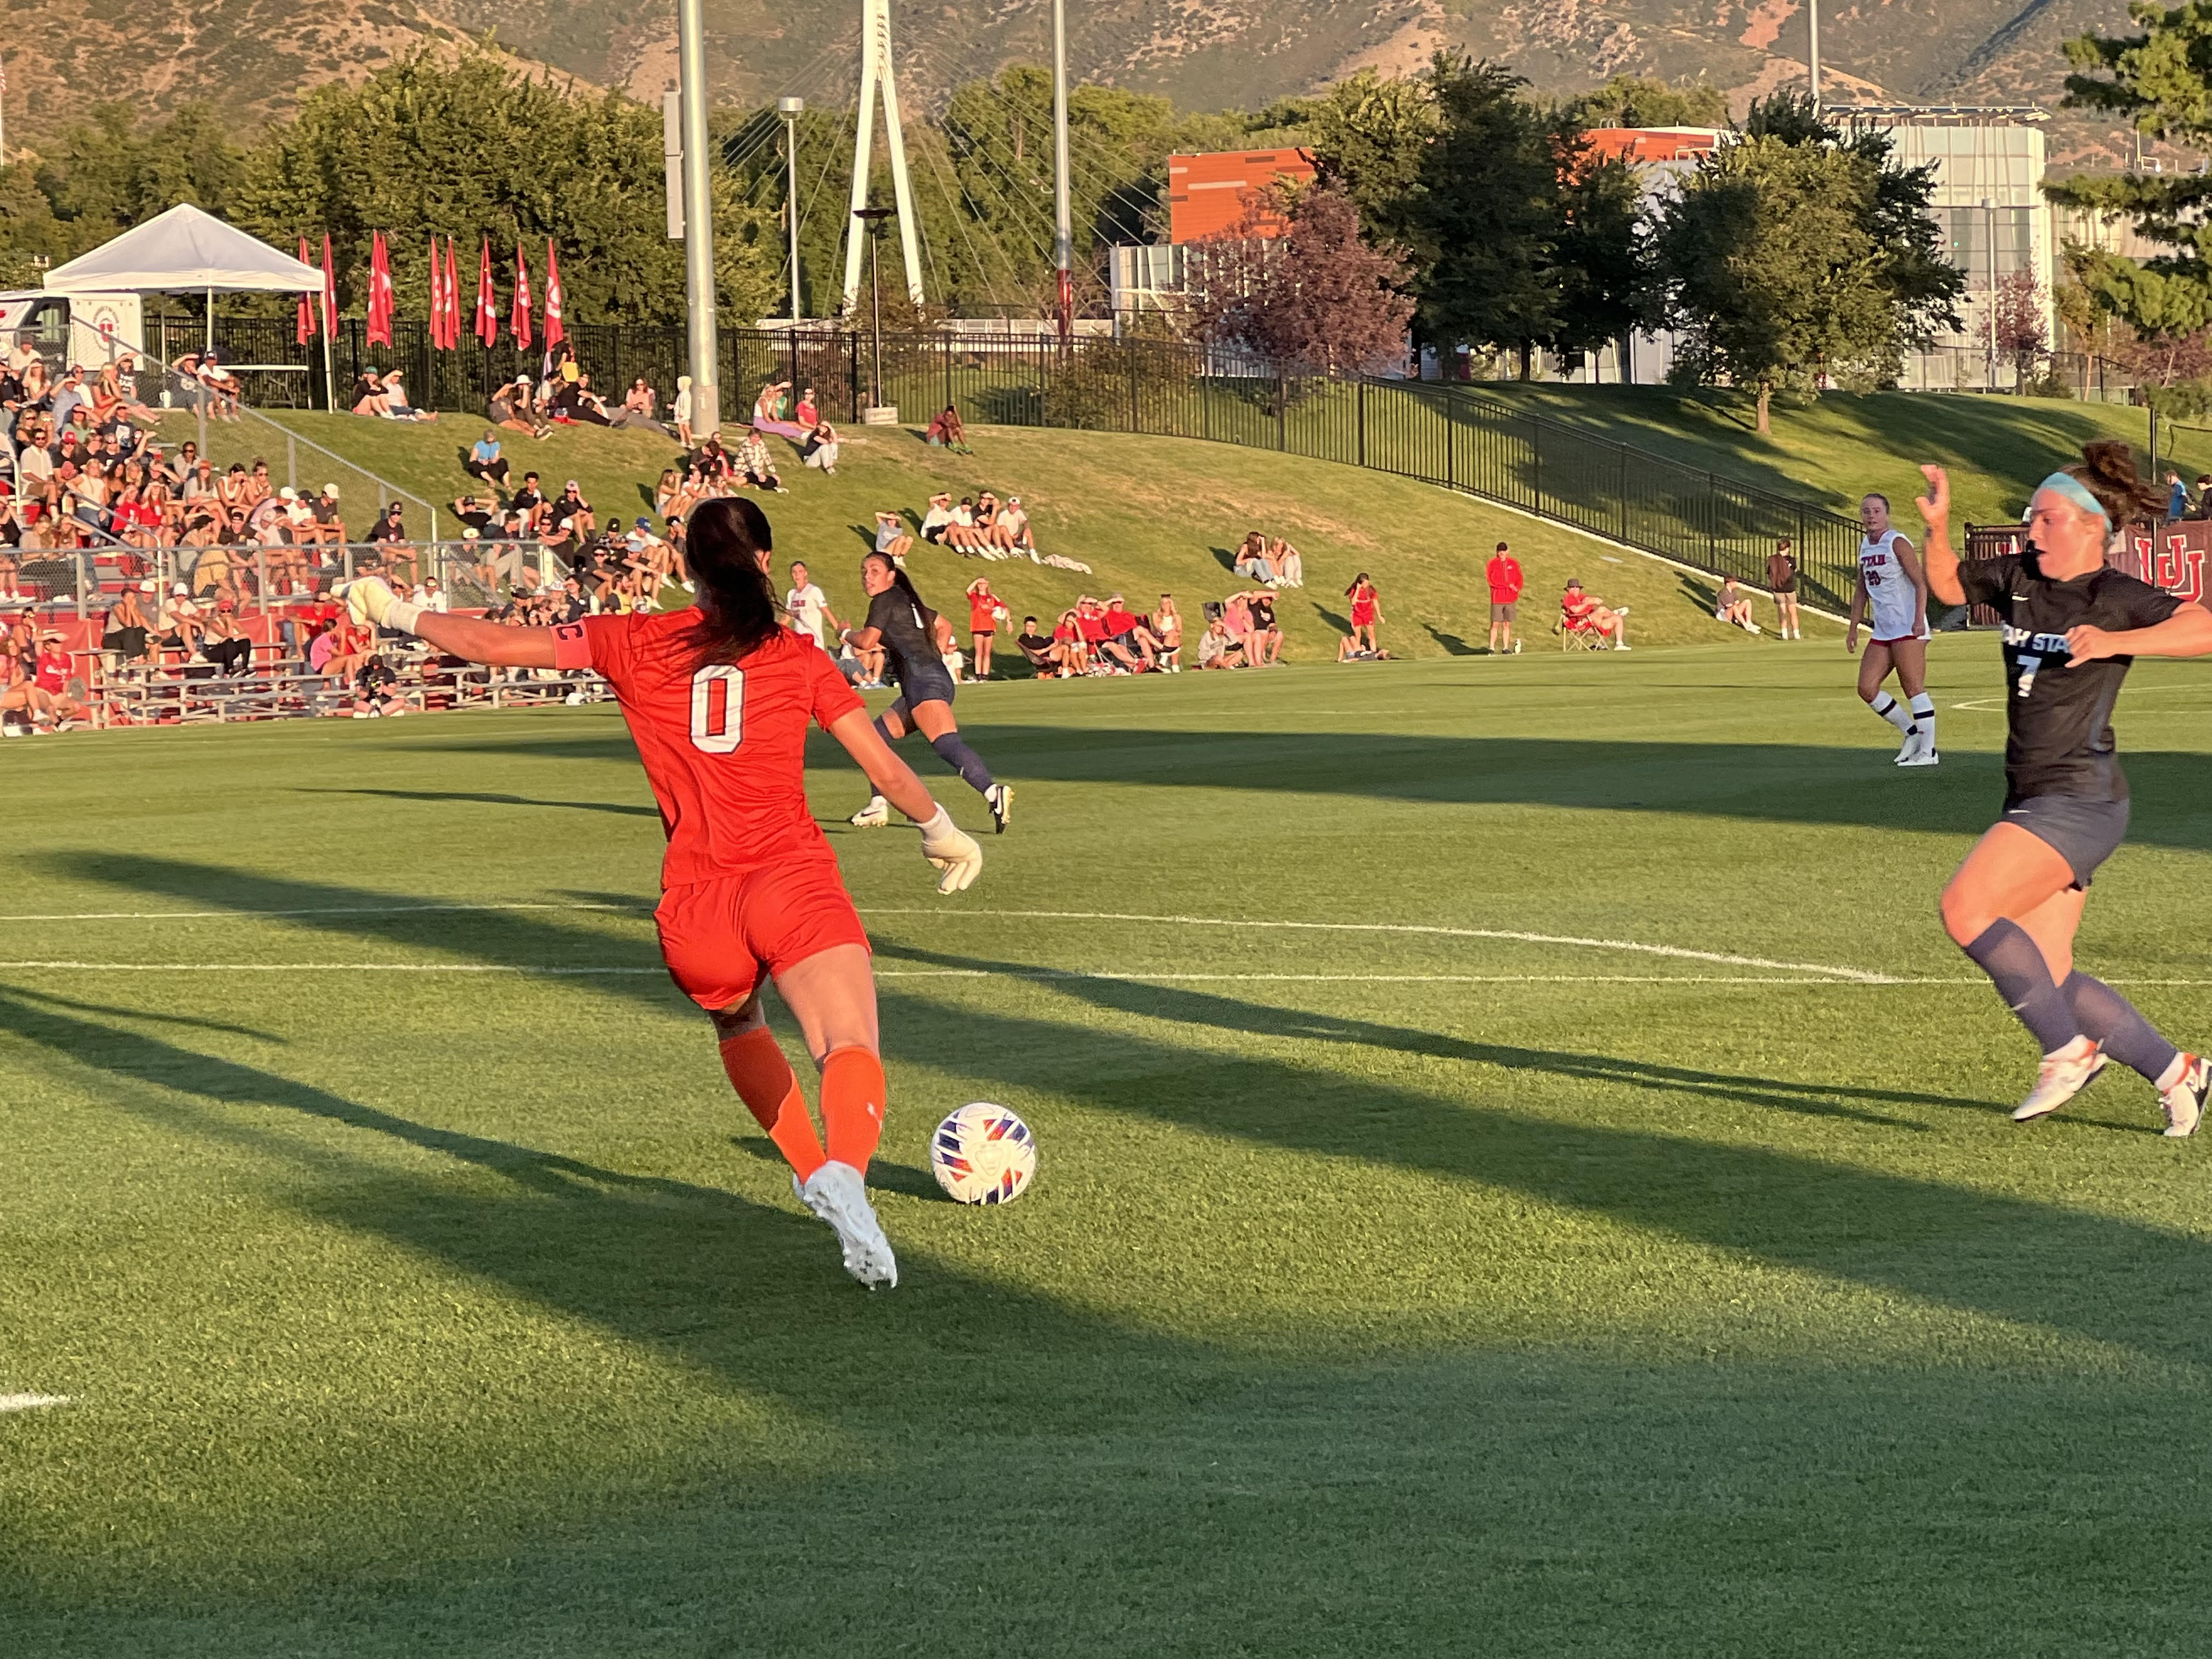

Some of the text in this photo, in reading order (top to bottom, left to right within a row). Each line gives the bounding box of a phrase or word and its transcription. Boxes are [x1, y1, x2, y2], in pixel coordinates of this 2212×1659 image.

[2032, 633, 2072, 653] STA
[2017, 654, 2042, 697] 7
[690, 664, 744, 754] 0
